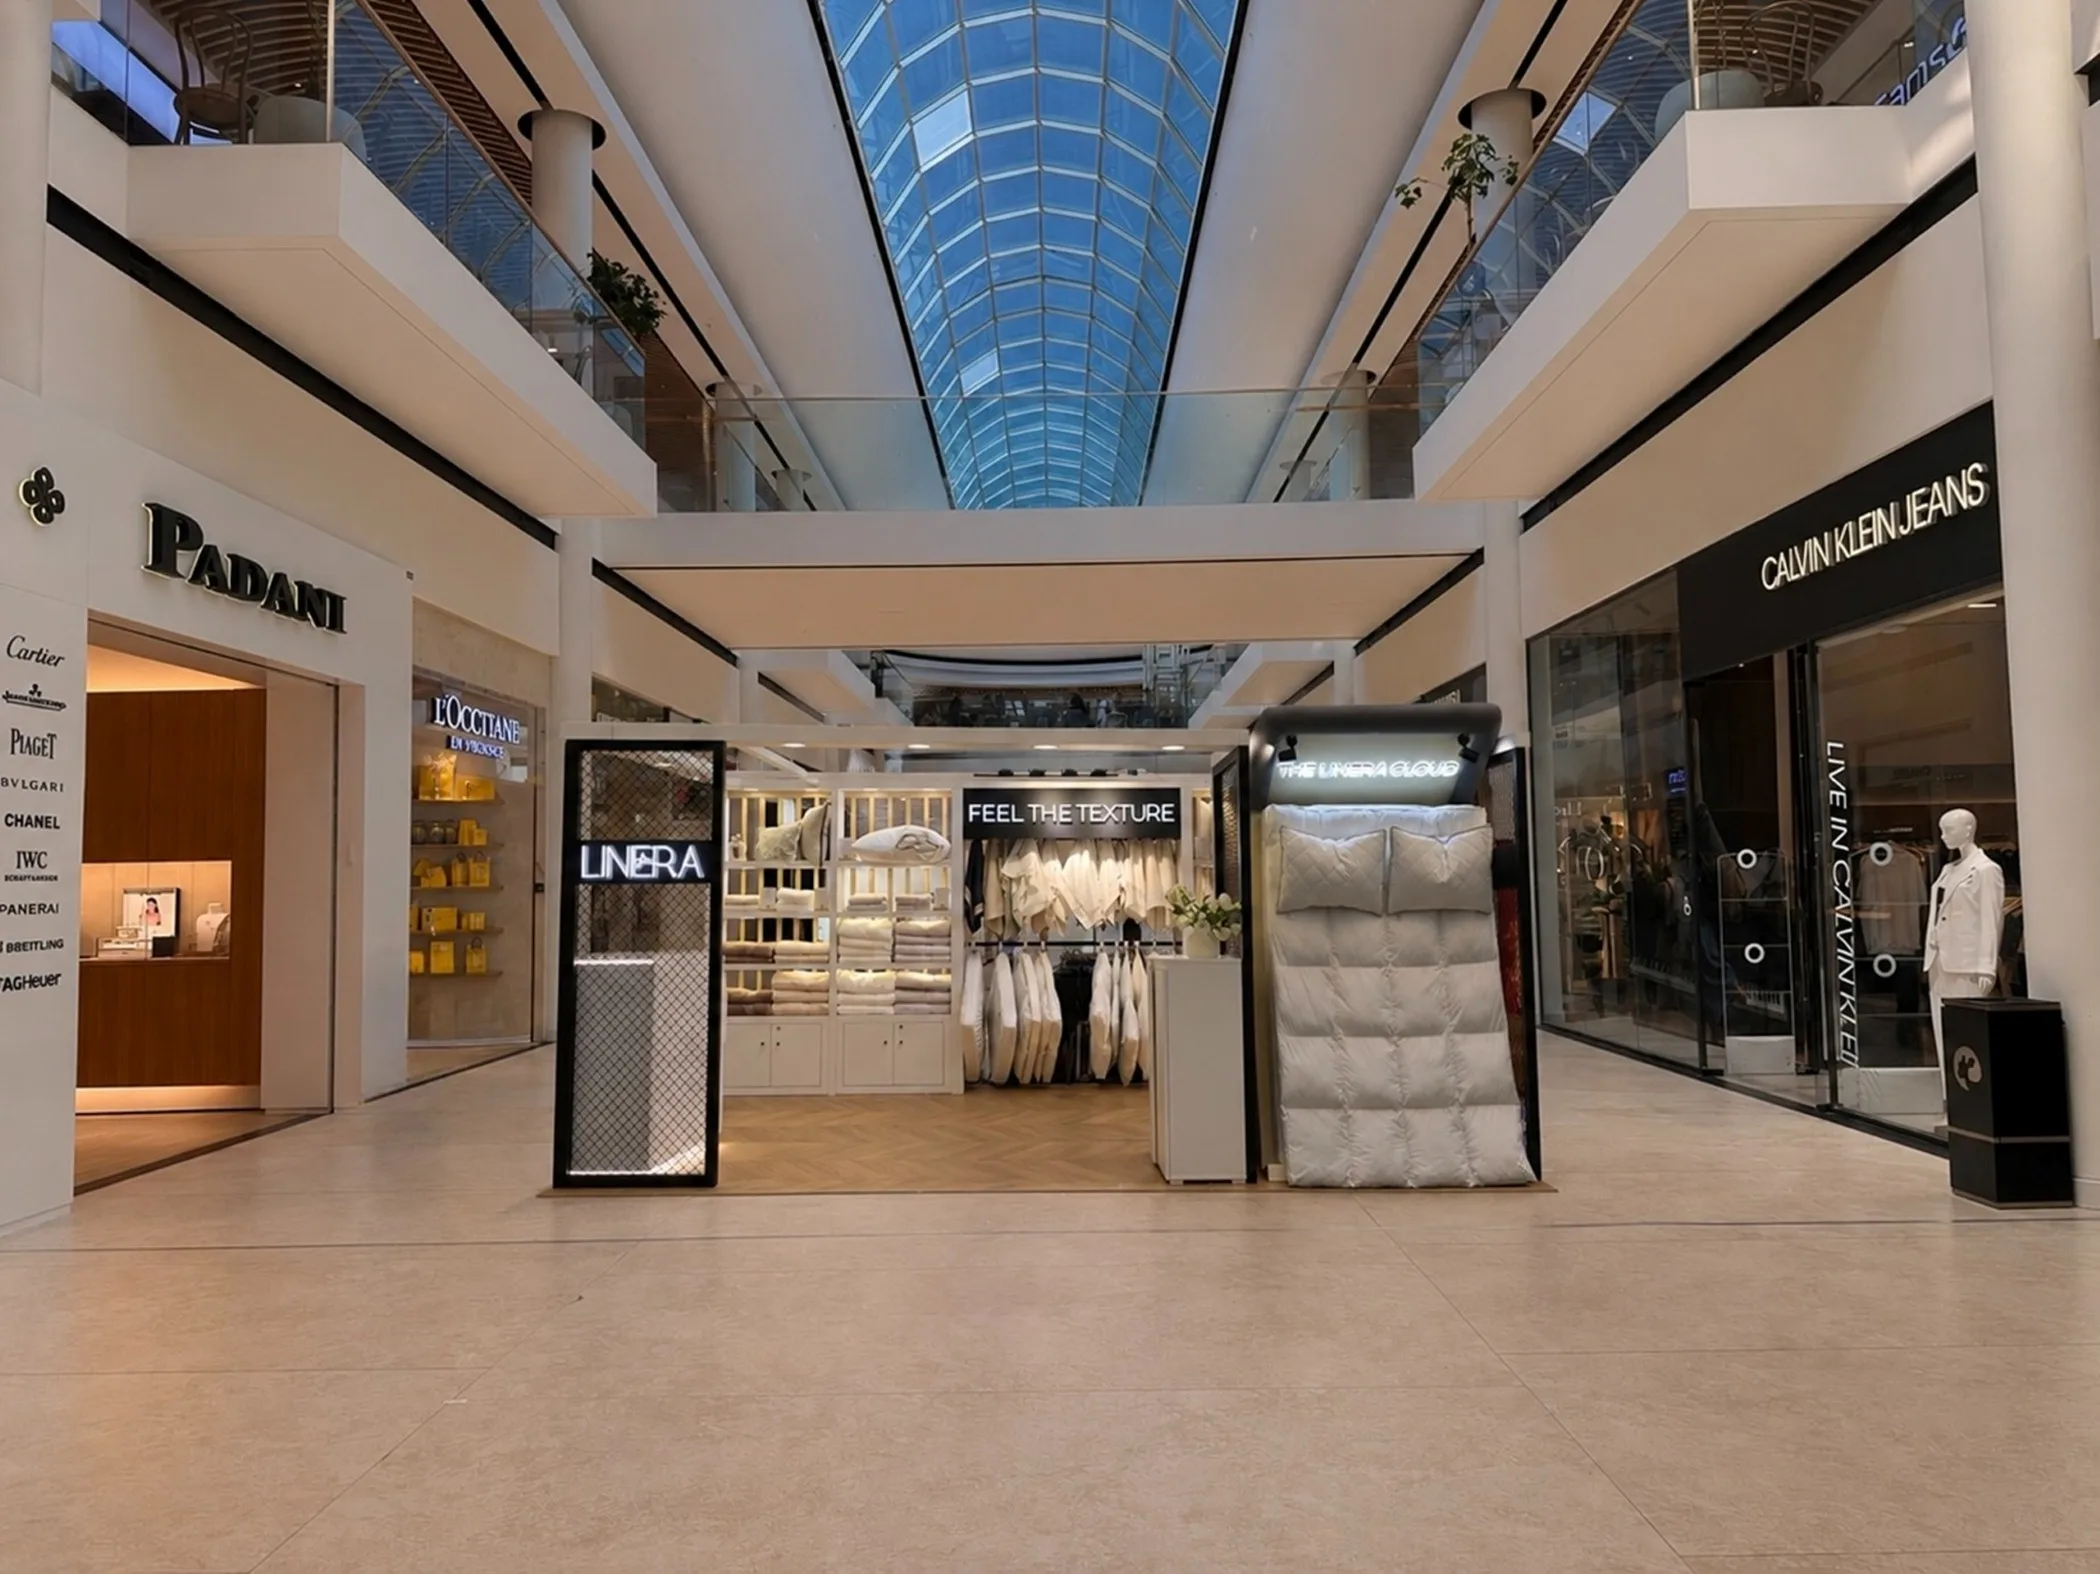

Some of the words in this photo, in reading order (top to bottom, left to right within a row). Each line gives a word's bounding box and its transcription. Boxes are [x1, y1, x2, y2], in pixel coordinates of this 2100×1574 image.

[1761, 531, 1832, 590] CALVIN
[1834, 501, 1901, 562] KLEIN
[1899, 462, 1990, 535] JEANS
[6, 634, 66, 667] Cartier
[1276, 761, 1316, 779] THE
[1827, 741, 1847, 809] LIVE
[0, 776, 64, 793] BVLGARI
[4, 812, 61, 830] CHANEL
[968, 804, 1025, 822] FEEL
[1027, 804, 1073, 823] THE
[1075, 803, 1176, 823] TEXTURE
[1830, 816, 1849, 851] IN
[16, 850, 48, 869] IWC
[1832, 859, 1856, 985] CALVIN
